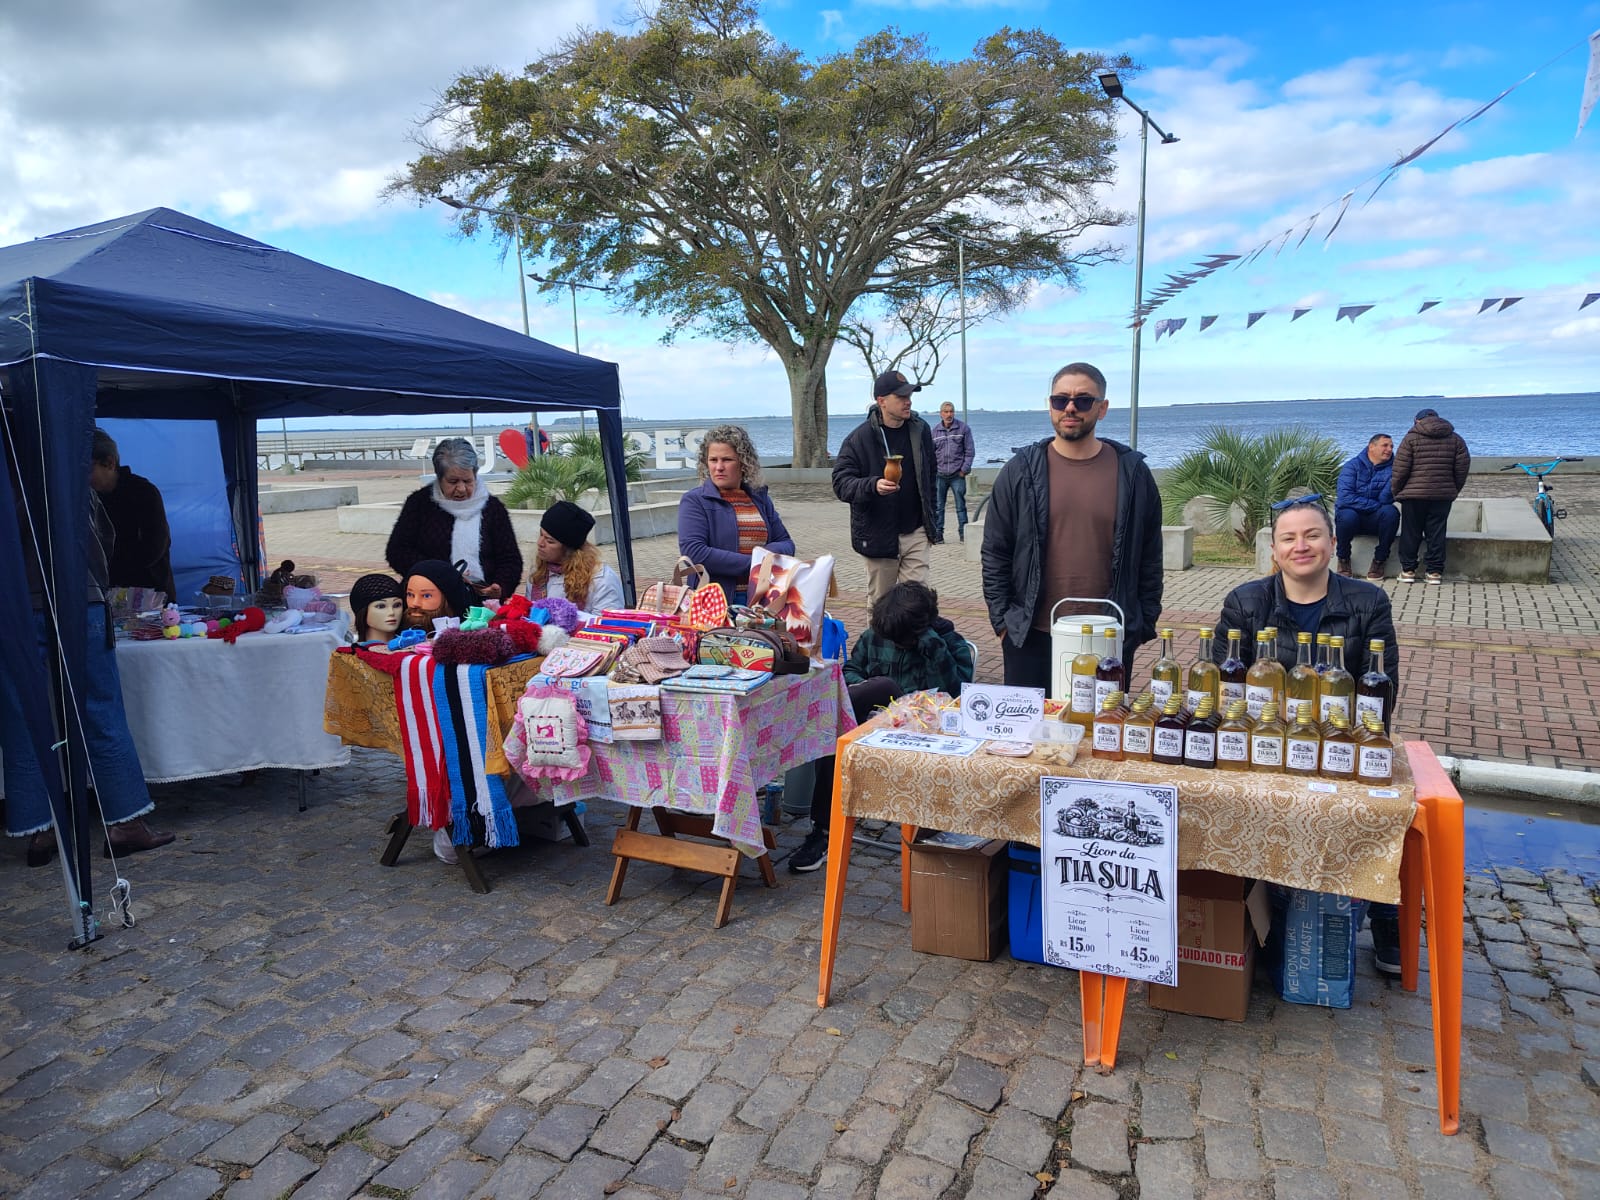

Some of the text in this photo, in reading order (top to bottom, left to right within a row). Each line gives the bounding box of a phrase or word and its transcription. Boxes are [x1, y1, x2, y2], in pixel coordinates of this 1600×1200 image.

[995, 701, 1040, 720] Gaúcho
[1080, 841, 1137, 860] Licor da
[1054, 856, 1167, 902] TIA SULA
[1067, 916, 1087, 926] Licor
[1130, 926, 1150, 936] Licor
[1130, 934, 1150, 944] 750ml
[1177, 946, 1222, 965] CUIDADO
[1299, 956, 1311, 971] TO
[1288, 979, 1300, 994] WE
